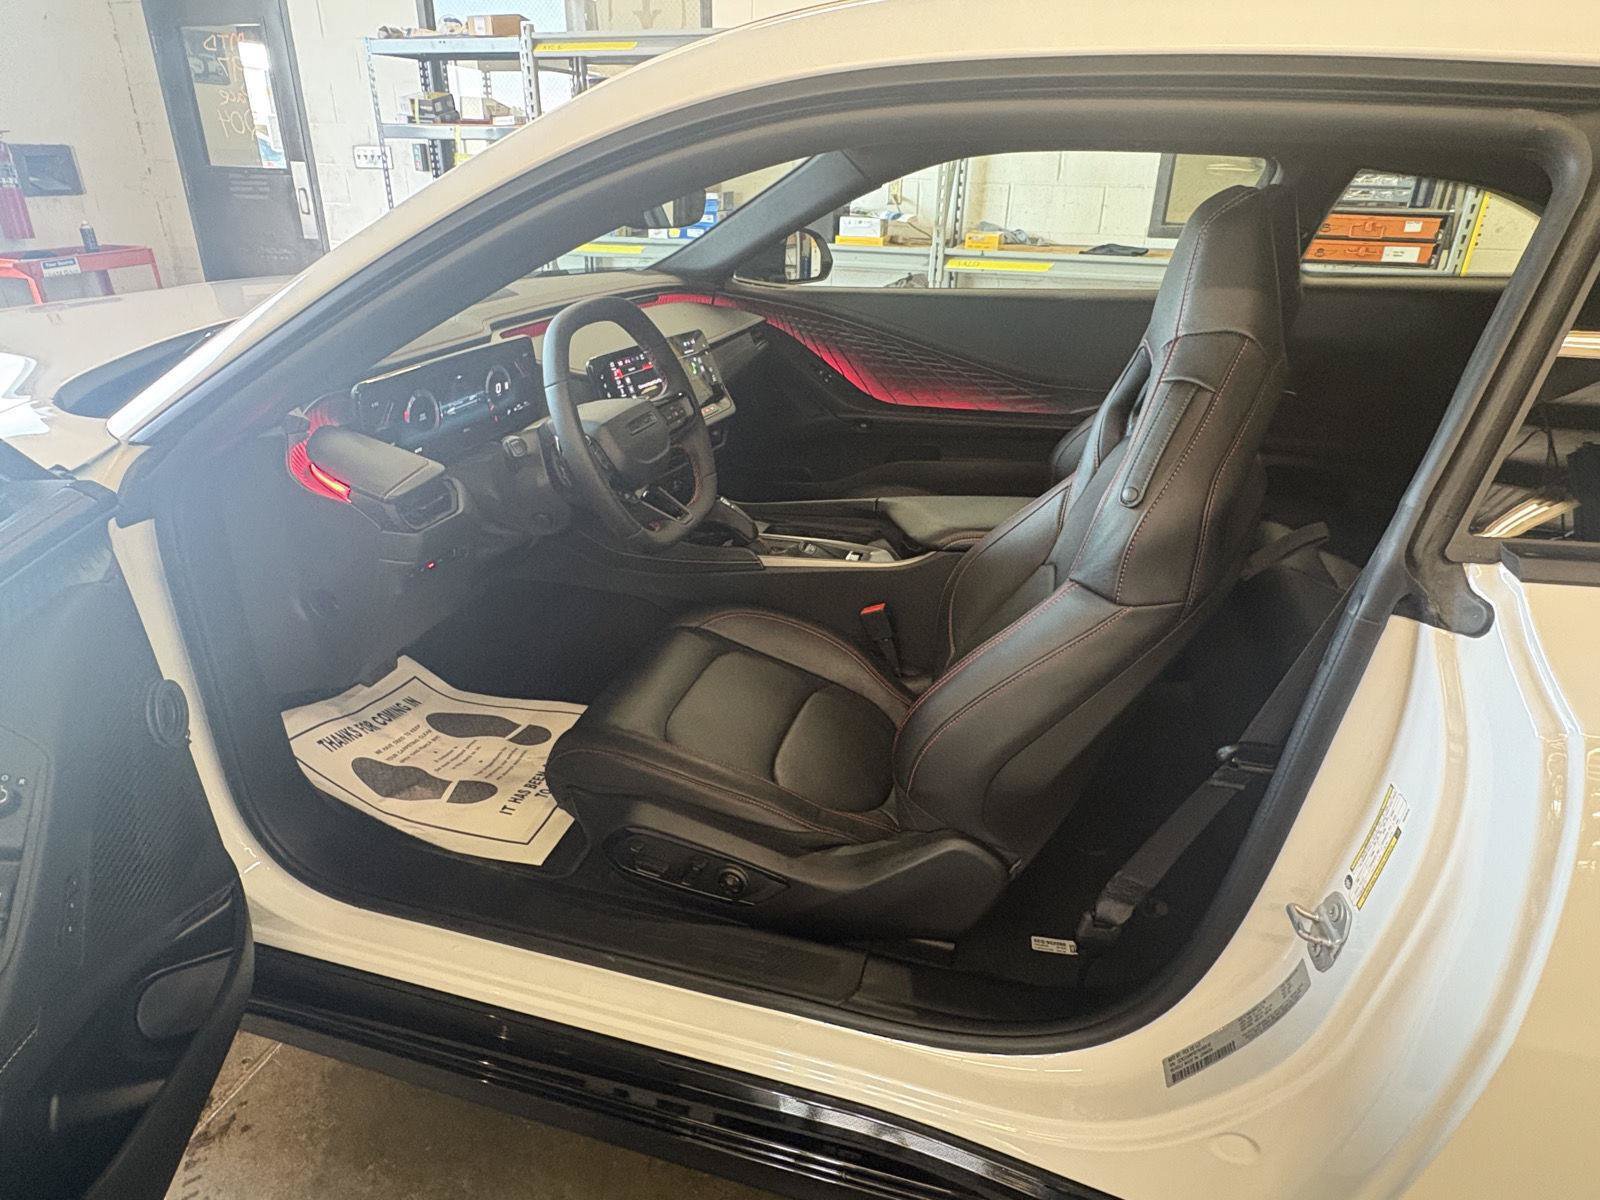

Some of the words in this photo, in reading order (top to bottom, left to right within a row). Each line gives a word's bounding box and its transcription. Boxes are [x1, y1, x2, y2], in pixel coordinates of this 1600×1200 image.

[316, 726, 363, 753] THANKS
[354, 720, 381, 735] FOR
[371, 702, 412, 726] COMING
[402, 696, 423, 708] IN
[507, 789, 531, 804] HAS
[499, 805, 516, 815] IT
